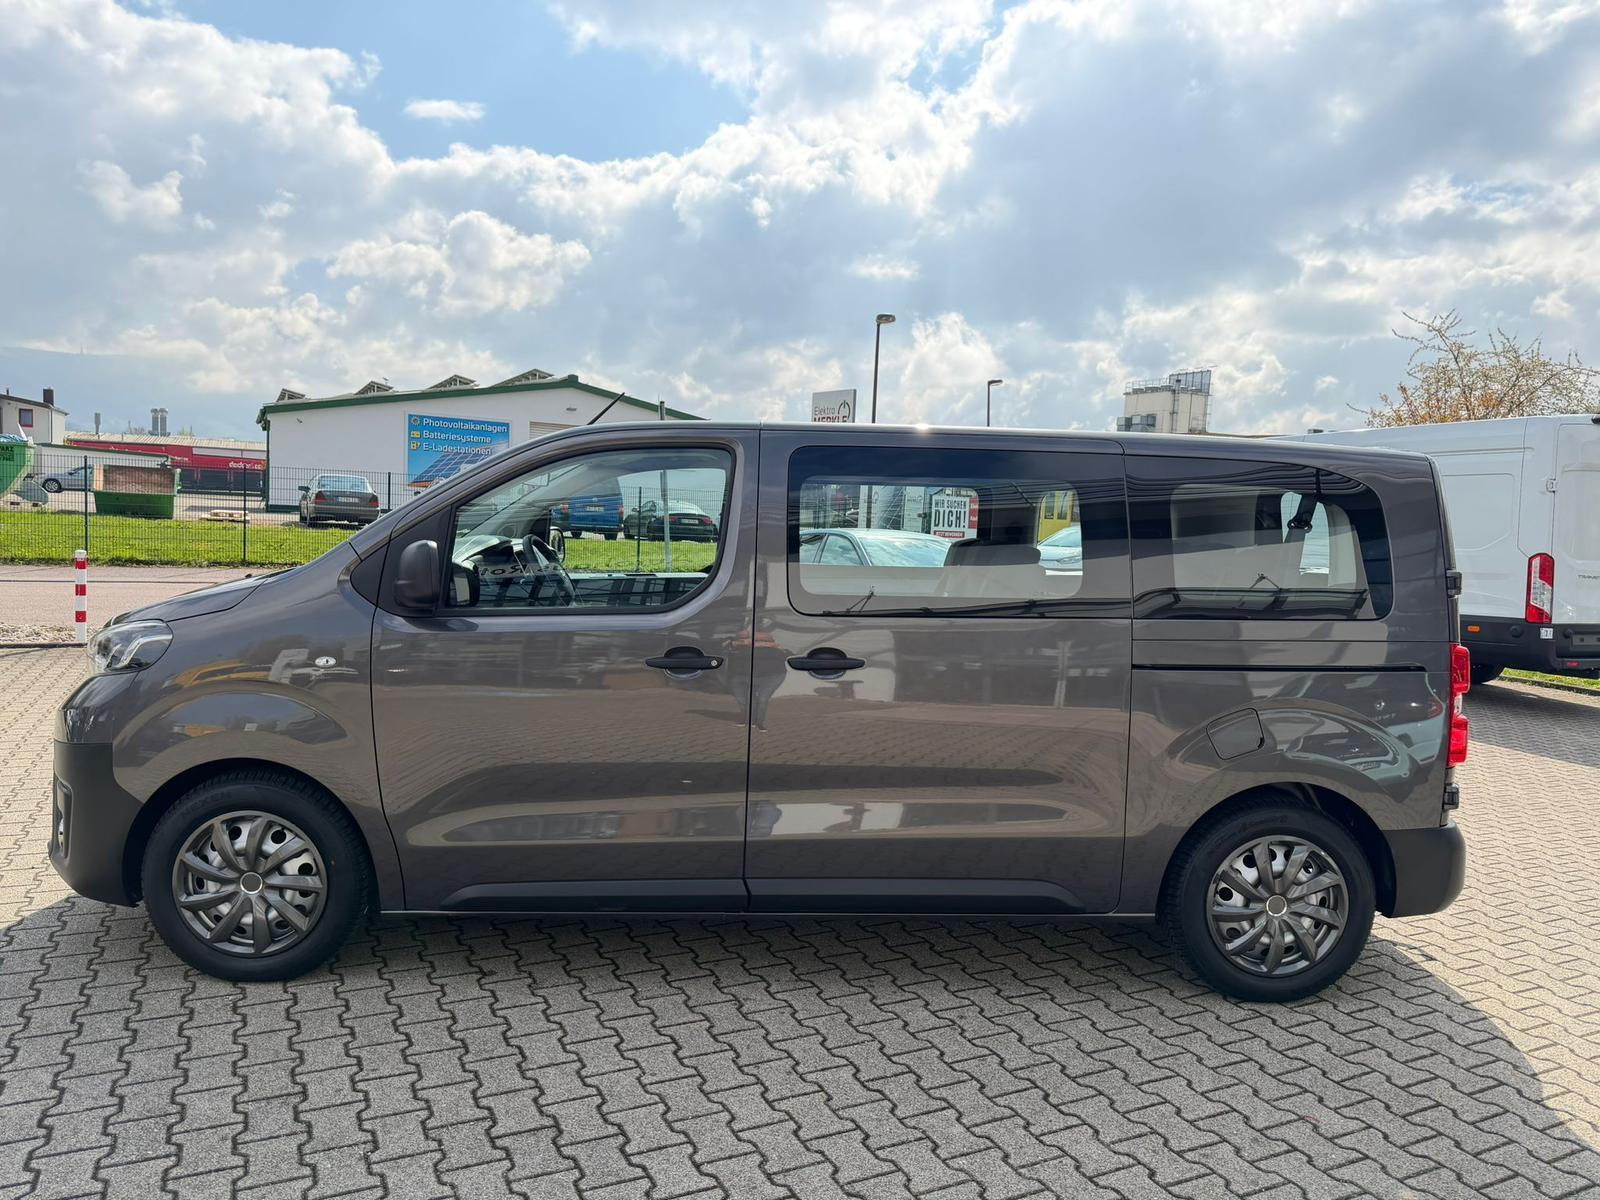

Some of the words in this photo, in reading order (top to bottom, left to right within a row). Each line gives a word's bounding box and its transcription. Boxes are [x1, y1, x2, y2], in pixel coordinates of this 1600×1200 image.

[814, 405, 836, 416] Elektro
[422, 418, 508, 434] Photovoltaikanlagen
[422, 430, 492, 444] Batteriesysteme
[422, 442, 492, 455] E-Ladestationen
[934, 499, 945, 509] WIR
[946, 500, 967, 510] SUCHEN
[933, 509, 967, 529] DICH!
